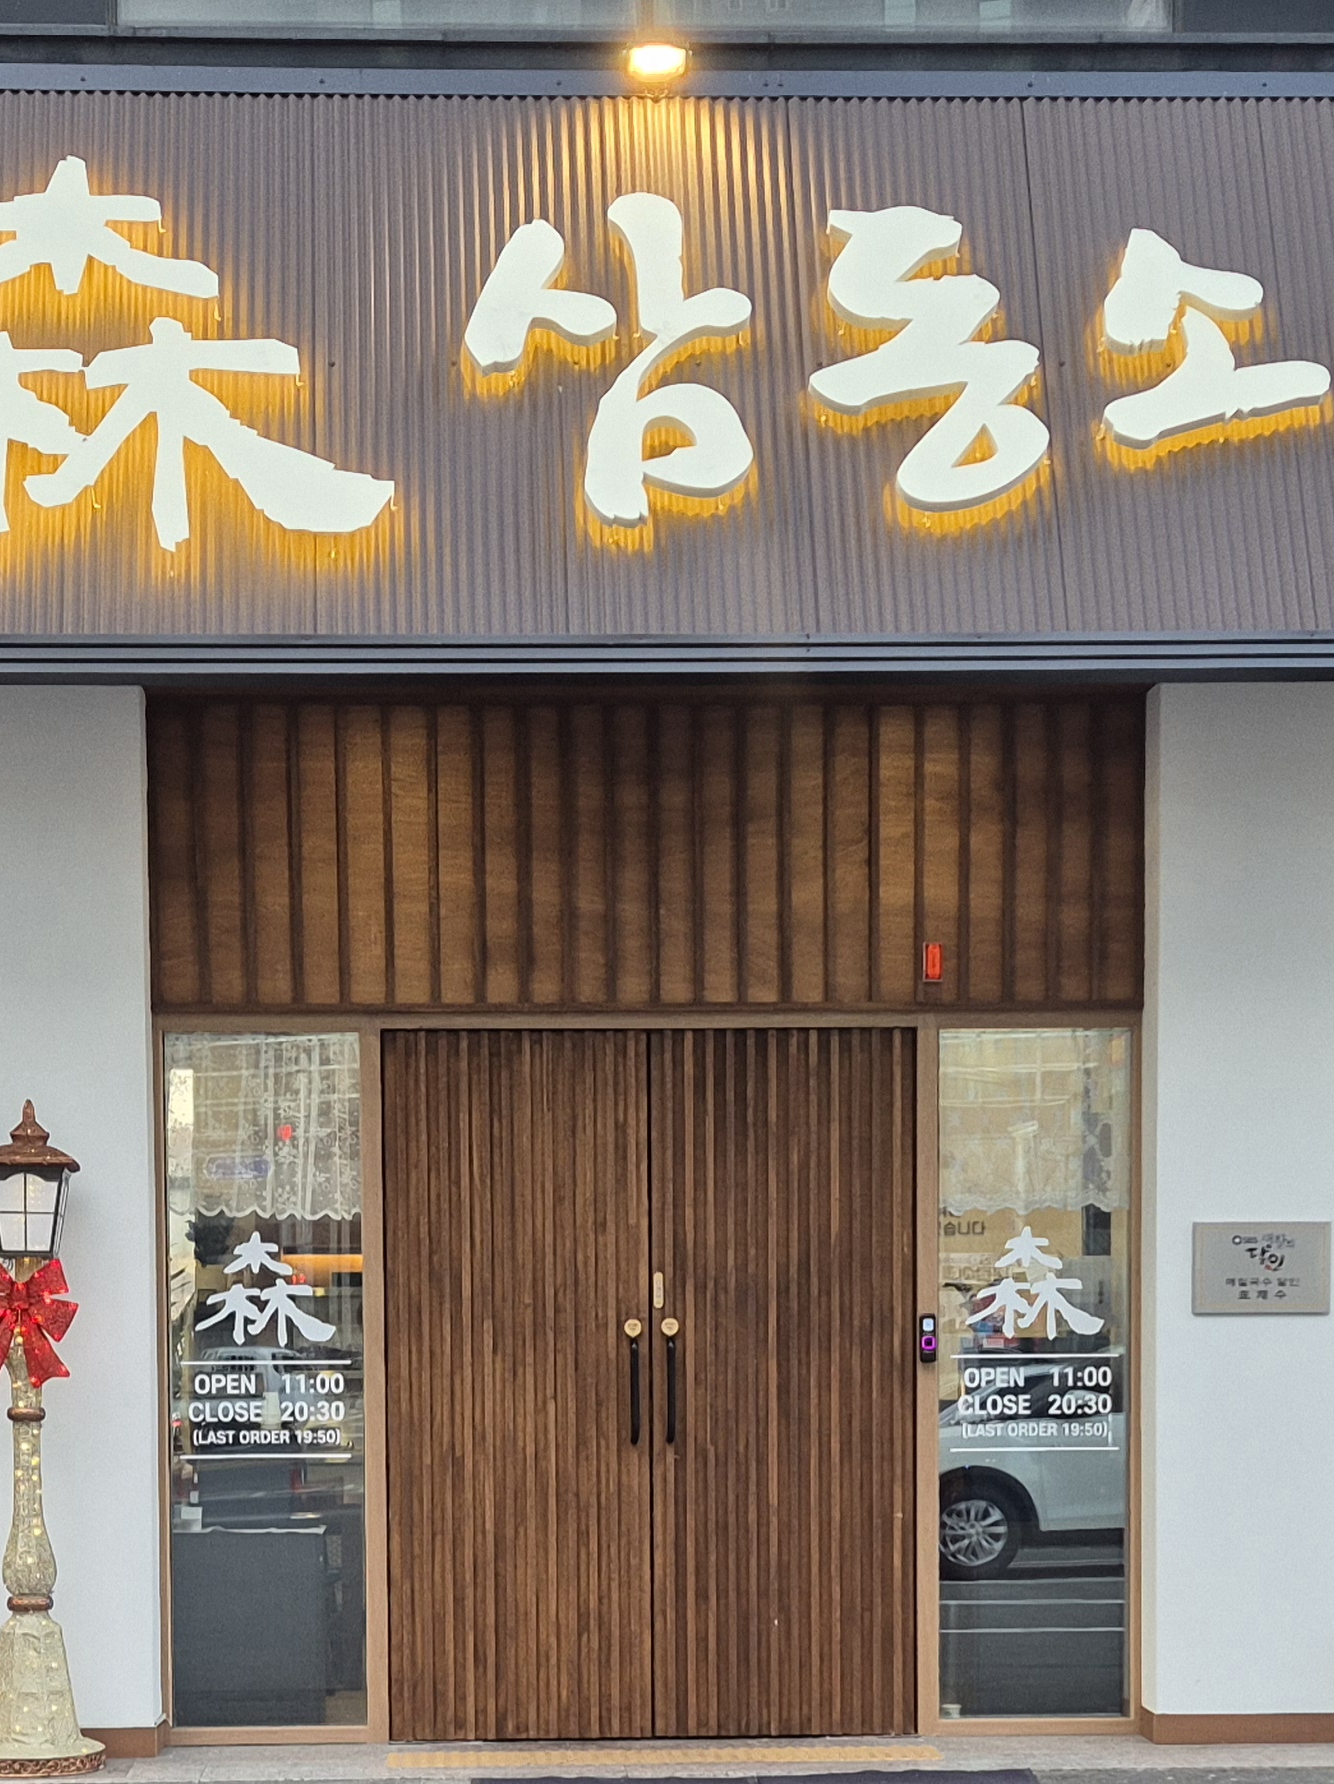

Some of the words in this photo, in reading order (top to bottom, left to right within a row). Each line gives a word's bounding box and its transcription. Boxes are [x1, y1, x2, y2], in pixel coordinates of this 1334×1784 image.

[195, 1231, 336, 1347] 森
[965, 1226, 1105, 1340] 森
[194, 1373, 257, 1395] OPEN
[281, 1372, 345, 1395] 11:00
[963, 1367, 1025, 1388] OPEN
[1049, 1366, 1113, 1388] 11:00
[188, 1401, 263, 1423] CLOSE
[280, 1400, 346, 1423] 20:30
[957, 1394, 1032, 1416] CLOSE
[1047, 1394, 1113, 1416] 20:30
[193, 1429, 236, 1446] (LAST
[239, 1430, 290, 1445] ORDER
[294, 1429, 342, 1446] 19:50)
[962, 1423, 1005, 1439] (LAST
[1007, 1423, 1058, 1438] ORDER
[1062, 1422, 1108, 1438] 19:50)
